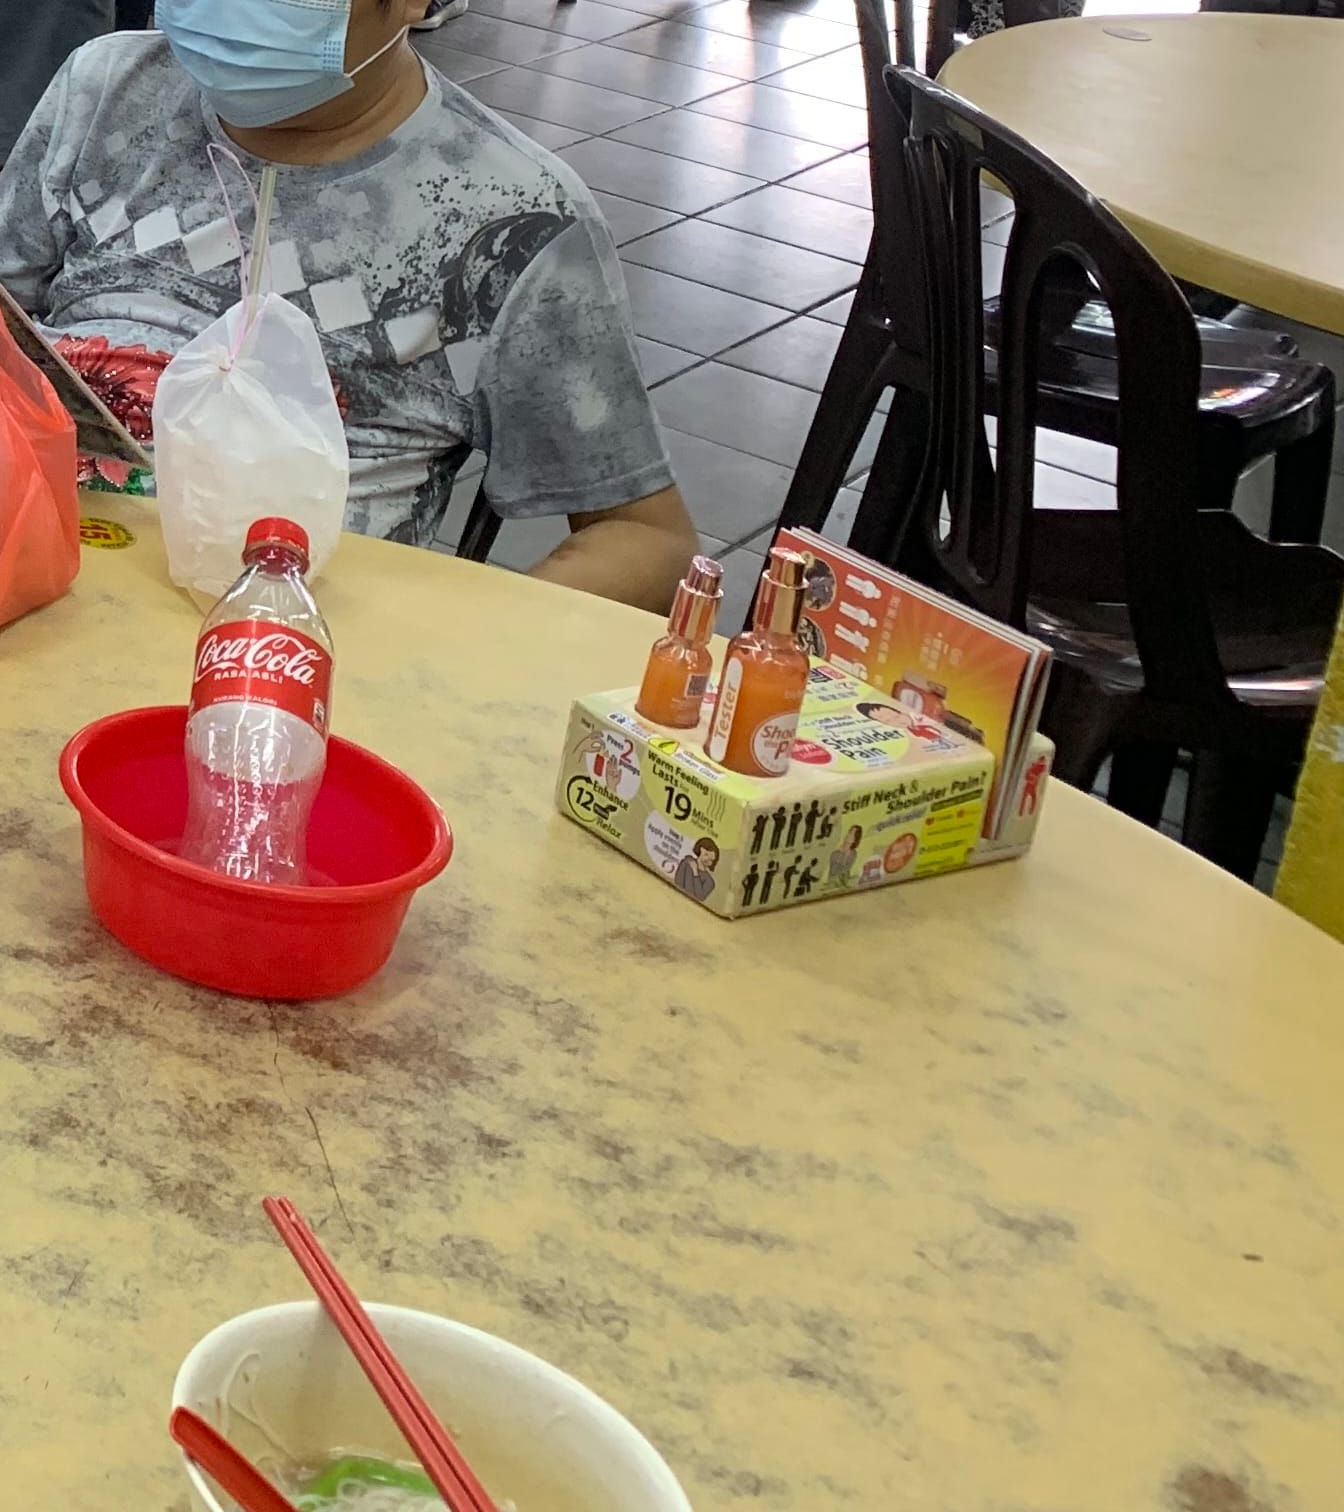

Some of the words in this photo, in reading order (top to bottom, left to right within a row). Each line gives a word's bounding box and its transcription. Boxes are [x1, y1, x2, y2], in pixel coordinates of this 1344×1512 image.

[214, 670, 248, 681] RASA
[251, 670, 284, 684] ASLI
[714, 681, 737, 740] Tester
[822, 728, 905, 750] Shoulder
[620, 739, 634, 764] 2
[839, 746, 887, 761] Pain
[648, 750, 674, 773] Warm
[675, 767, 710, 796] Feeling
[652, 764, 679, 788] Lasts
[576, 787, 594, 811] 12
[593, 779, 629, 811] Enhance
[664, 785, 692, 822] 19
[842, 794, 872, 814] Stiff
[873, 784, 907, 804] Neck
[886, 787, 947, 815] Shoulder
[951, 770, 987, 794] Pain?
[596, 819, 622, 839] Relax
[692, 808, 714, 829] Mins
